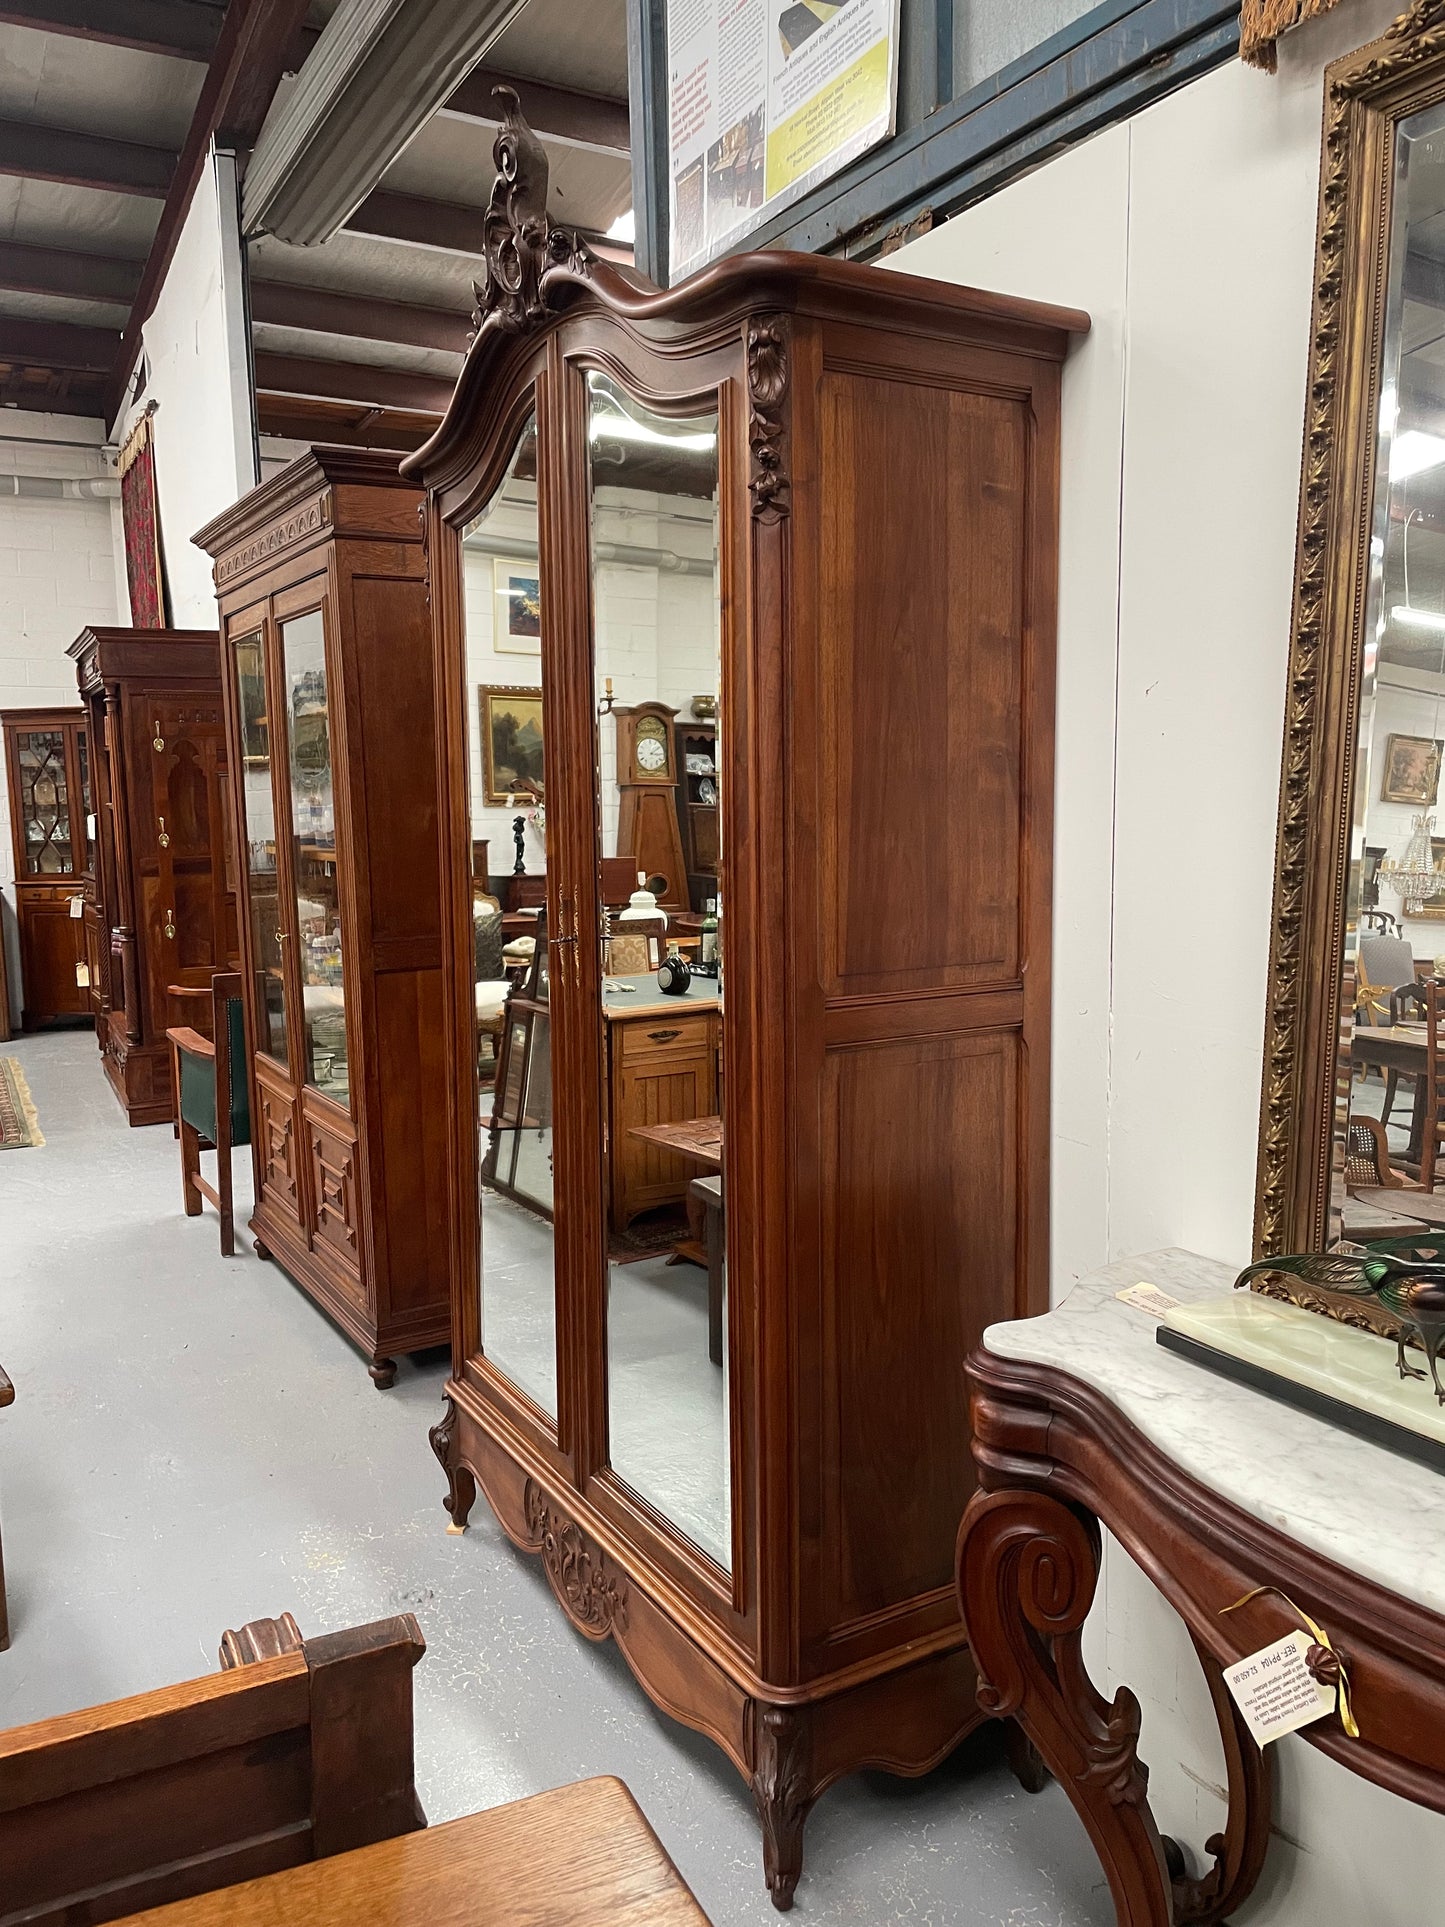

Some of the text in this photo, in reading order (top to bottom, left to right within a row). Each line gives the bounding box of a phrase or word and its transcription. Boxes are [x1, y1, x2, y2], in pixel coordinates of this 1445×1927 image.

[788, 48, 808, 71] Antiques
[809, 38, 817, 52] and
[819, 22, 836, 44] English
[837, 1, 858, 29] Antiques
[1260, 1652, 1281, 1668] PP104
[1281, 1669, 1291, 1678] good
[1301, 1679, 1310, 1687] style
[1292, 1684, 1301, 1692] with
[1281, 1689, 1292, 1697] white
[1268, 1695, 1281, 1704] marble
[1293, 1698, 1308, 1710] Century
[1259, 1710, 1268, 1718] Louis
[1280, 1707, 1294, 1717] French
